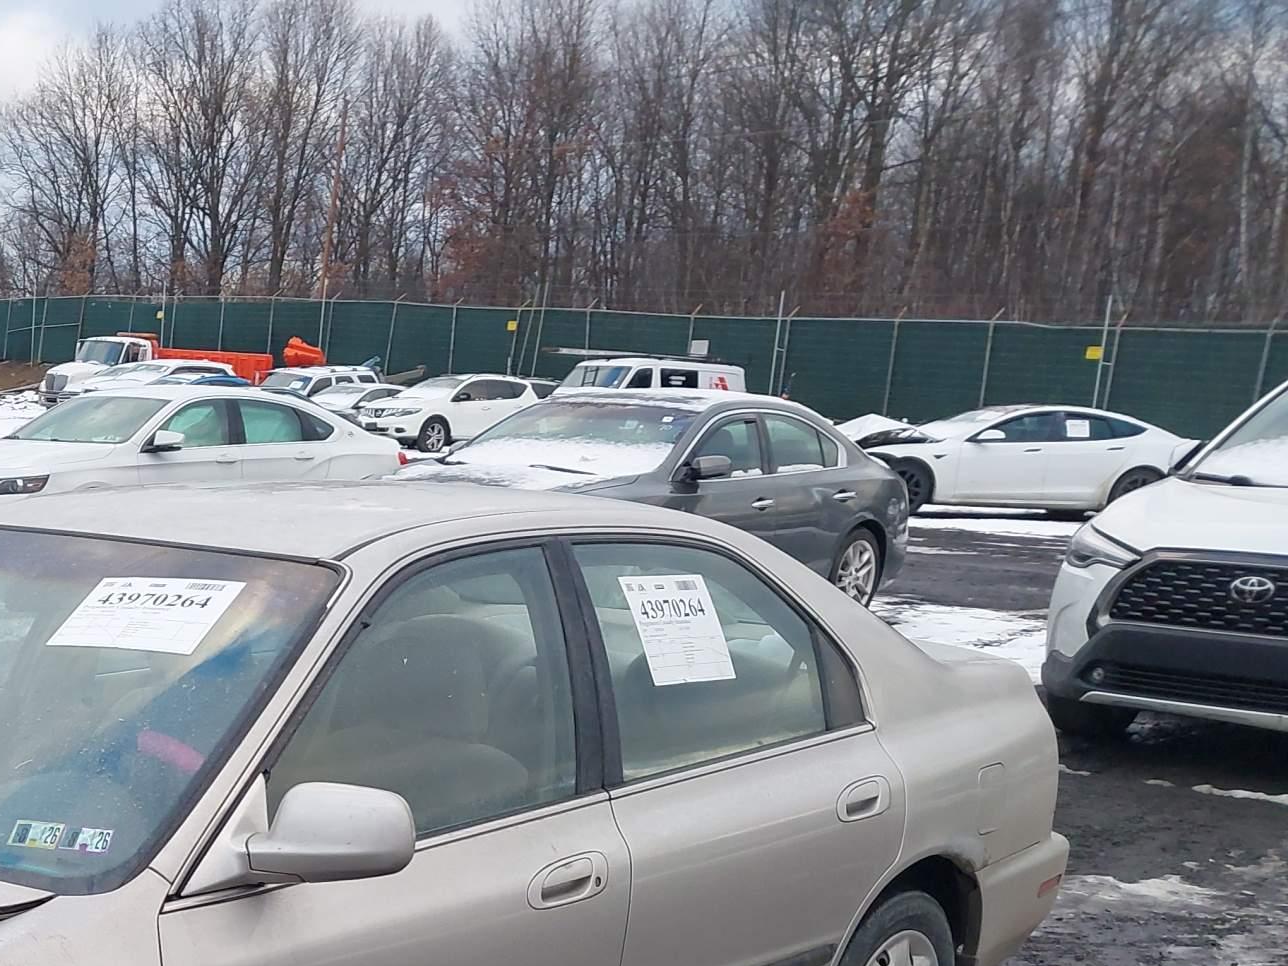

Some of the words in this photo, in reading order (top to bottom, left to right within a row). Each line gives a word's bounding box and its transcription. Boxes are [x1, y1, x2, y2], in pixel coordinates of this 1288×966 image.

[98, 592, 212, 608] 43970264
[640, 598, 706, 619] 43970264
[43, 826, 60, 845] 26
[95, 831, 111, 850] 26
